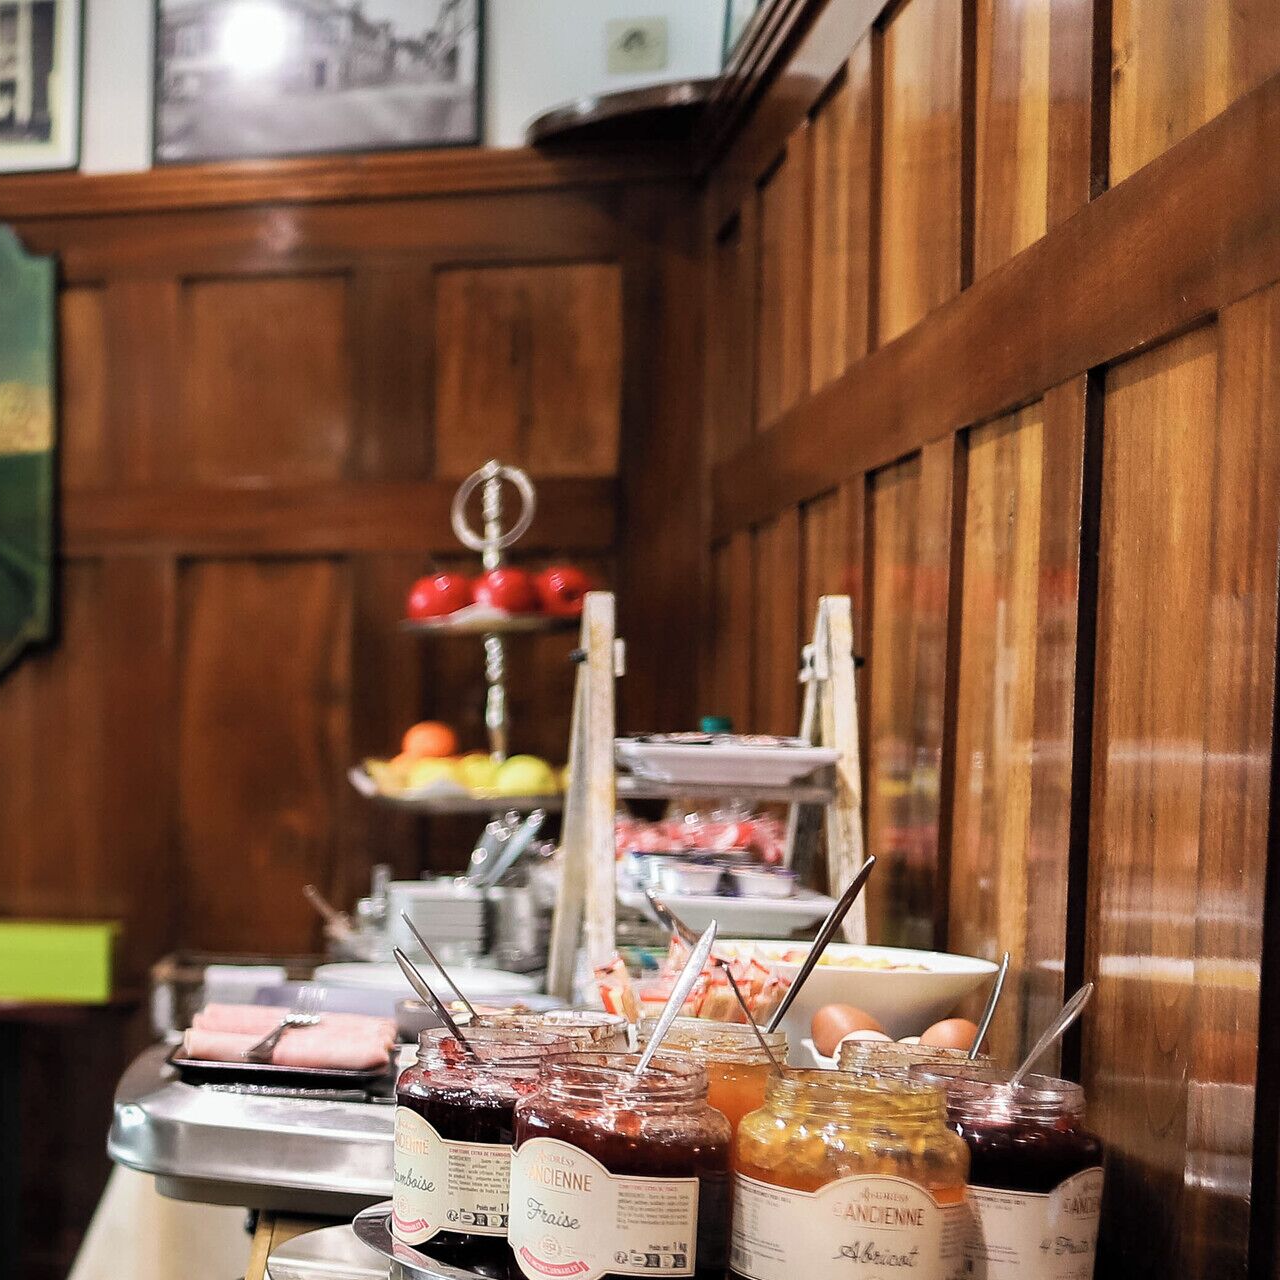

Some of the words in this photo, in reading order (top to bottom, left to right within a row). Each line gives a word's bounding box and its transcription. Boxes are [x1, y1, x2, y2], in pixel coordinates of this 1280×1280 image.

[527, 1197, 581, 1230] Fraise
[846, 1202, 925, 1226] ANCIENNE
[832, 1240, 920, 1268] Abricot
